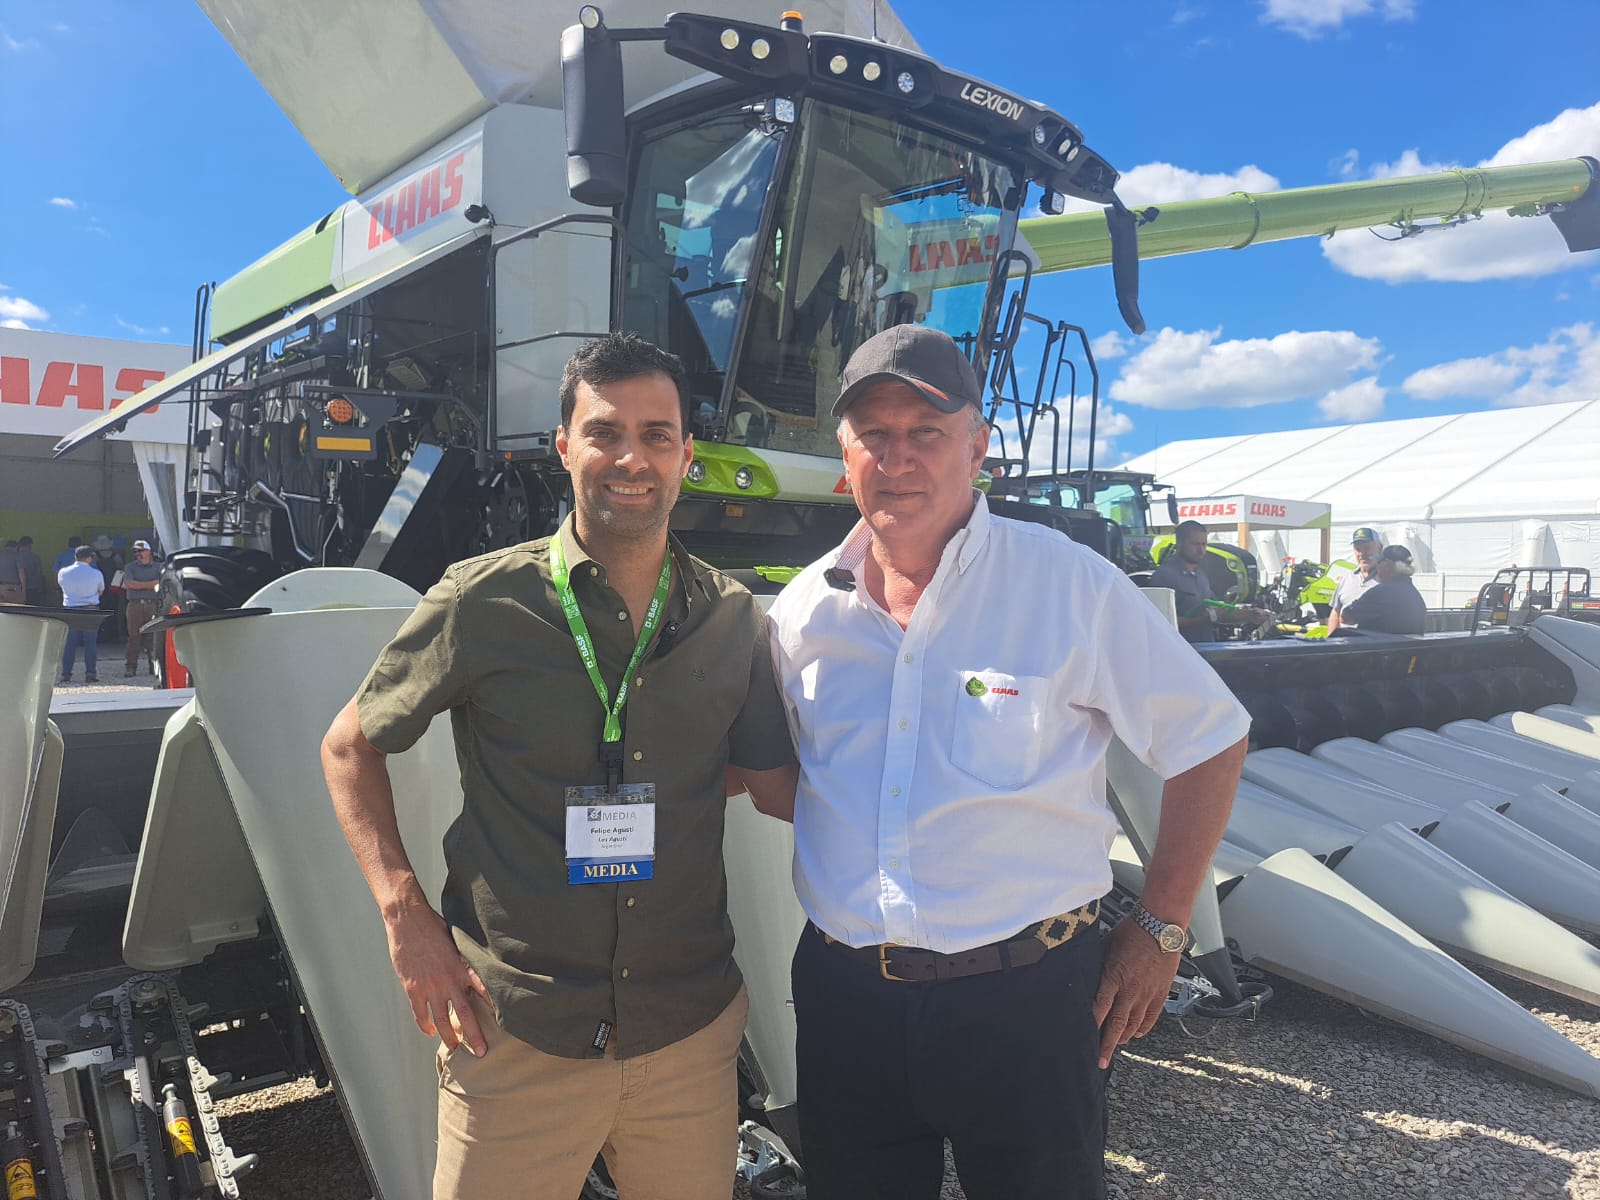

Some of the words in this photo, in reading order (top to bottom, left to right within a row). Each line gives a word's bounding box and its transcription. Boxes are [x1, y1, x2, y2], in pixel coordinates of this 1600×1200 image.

[960, 82, 1025, 121] LEXION
[367, 151, 465, 251] CLAAS
[1179, 503, 1237, 518] CLAAS
[1250, 502, 1286, 518] CLAAS
[576, 634, 589, 657] BASF
[602, 811, 637, 821] MEDIA
[590, 827, 611, 835] Felipe
[583, 863, 639, 878] MEDIA
